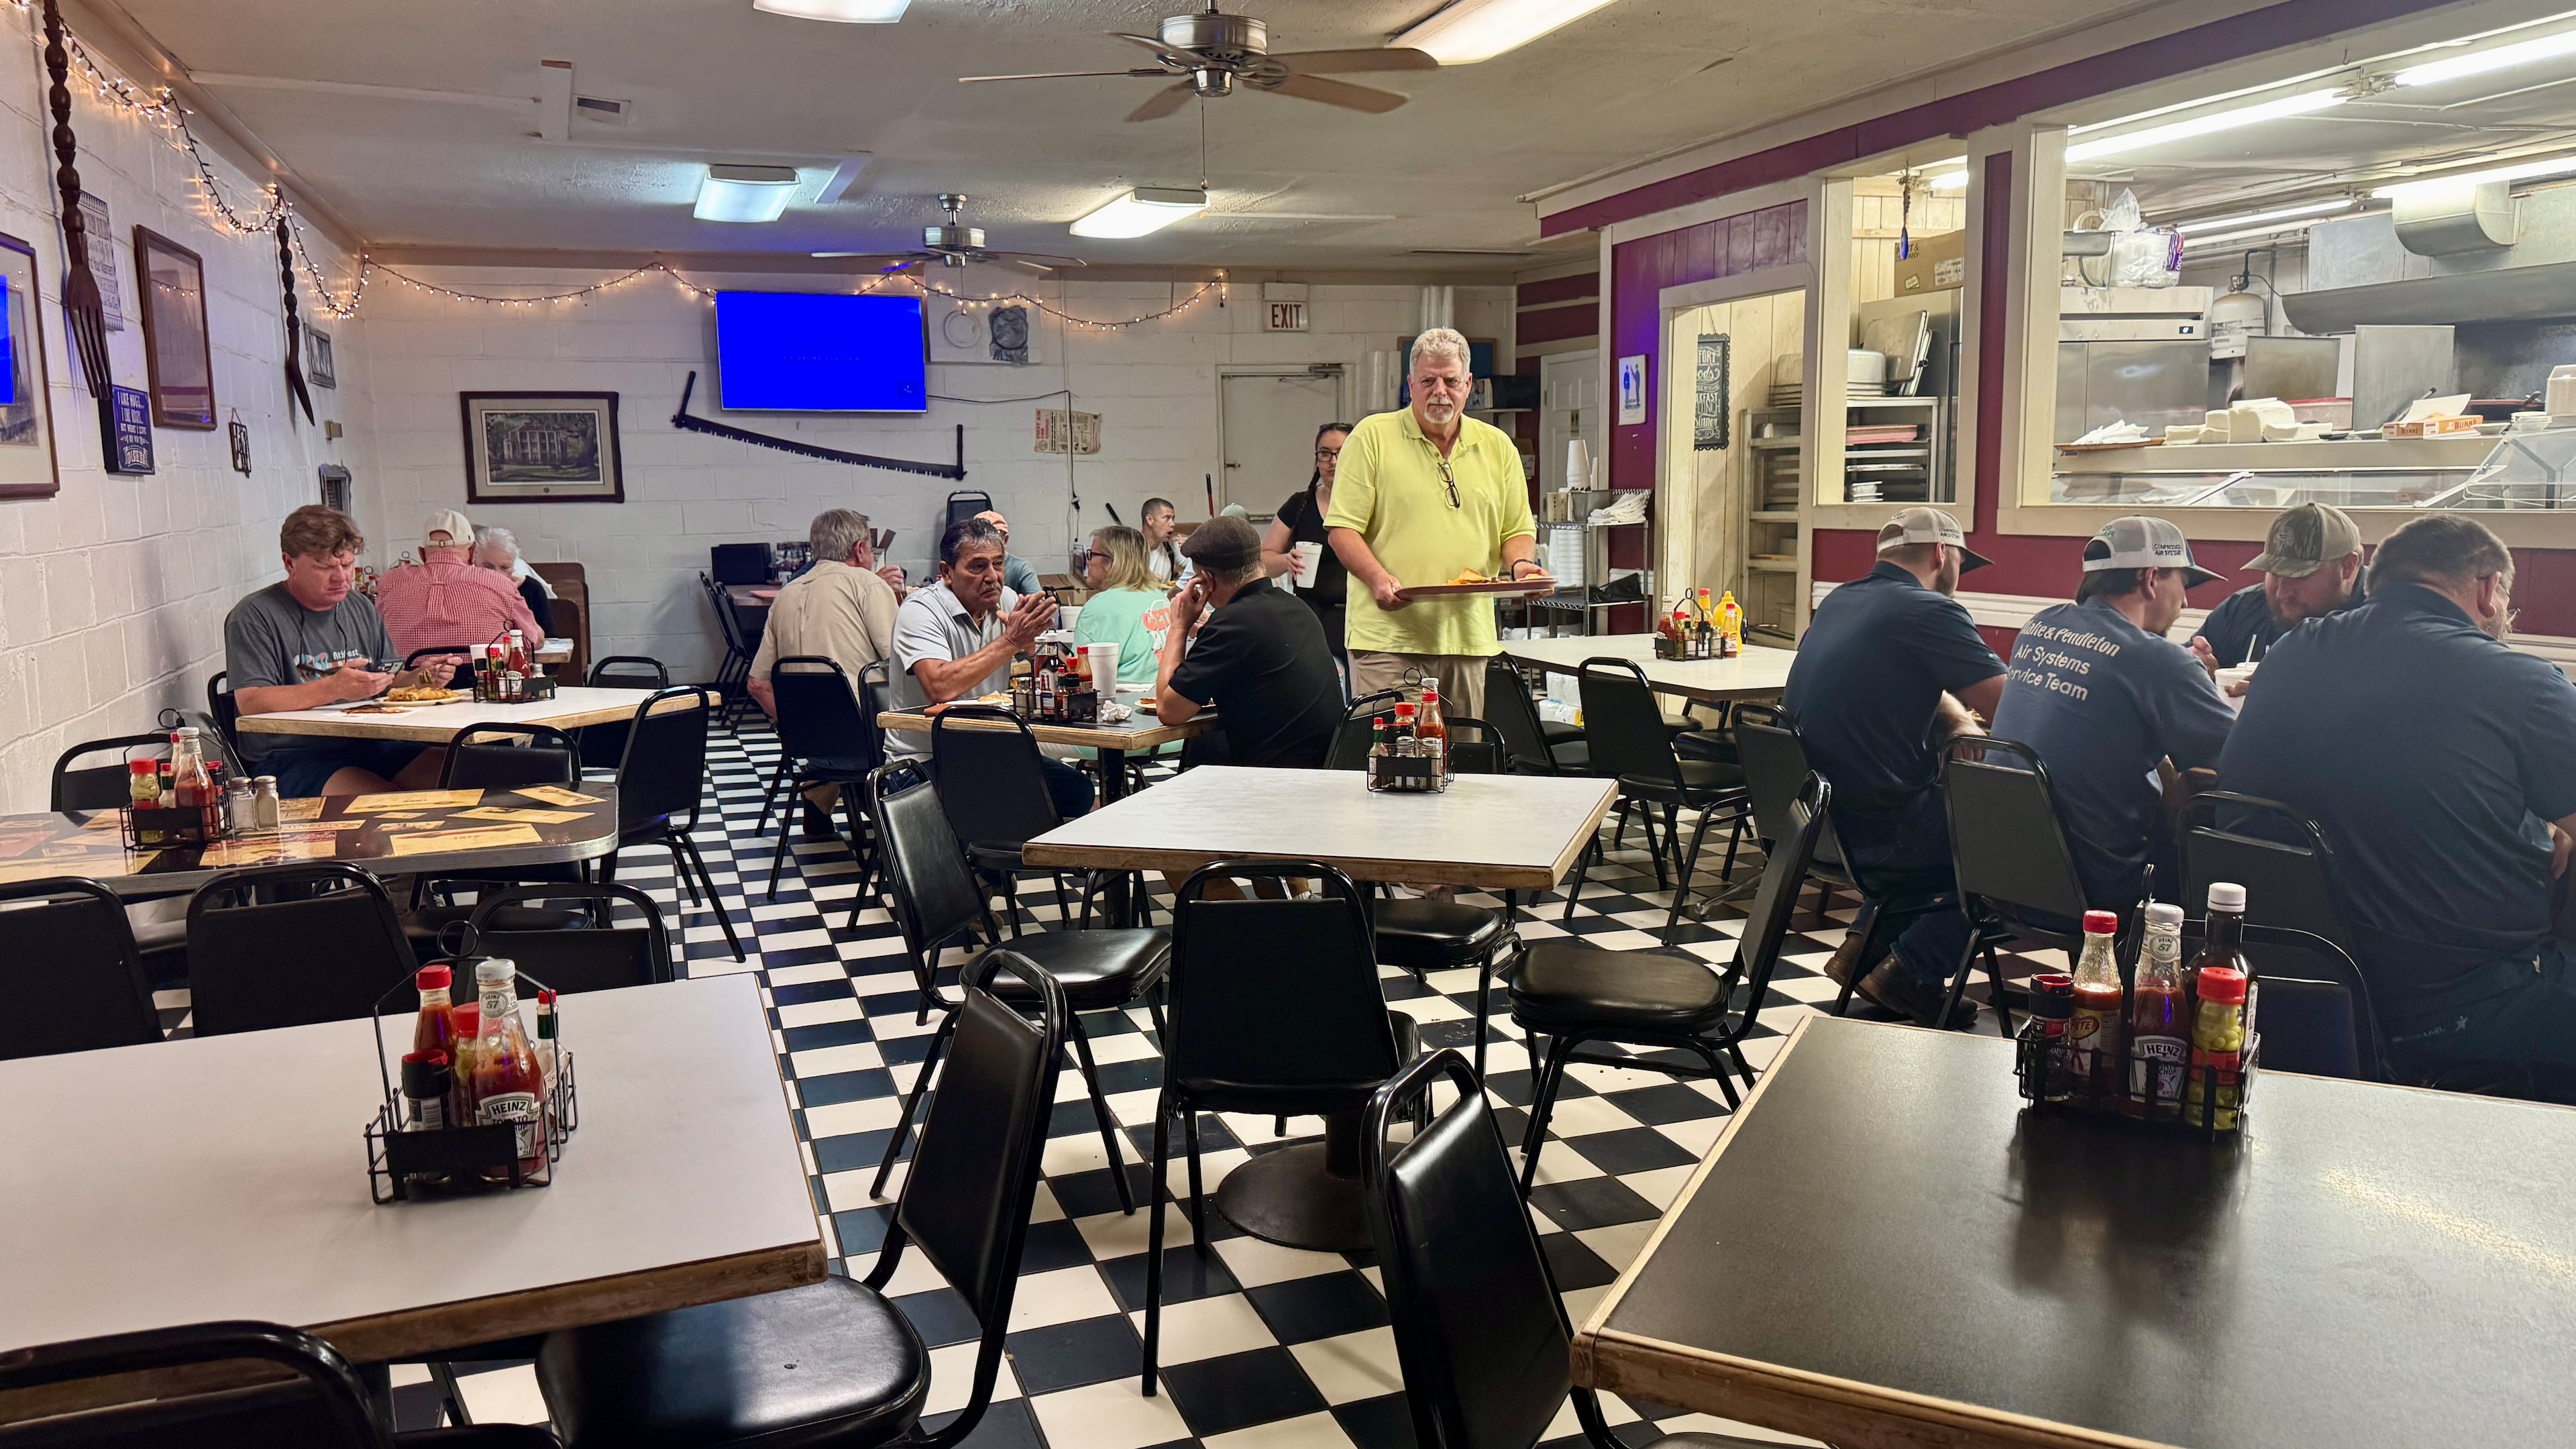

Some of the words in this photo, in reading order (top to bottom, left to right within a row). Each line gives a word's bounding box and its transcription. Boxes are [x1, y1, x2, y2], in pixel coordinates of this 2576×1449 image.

[1271, 304, 1301, 328] EXIT
[1698, 350, 1716, 364] FORT
[1697, 367, 1720, 380] ods
[1697, 392, 1718, 404] AKFAST
[2043, 627, 2056, 639] &
[2053, 628, 2121, 657] Pendleton
[333, 648, 359, 661] Athest
[2014, 644, 2032, 659] Air
[2033, 646, 2091, 675] Systems
[2045, 672, 2088, 701] Team
[2158, 943, 2172, 952] 57
[486, 1000, 499, 1009] 57
[2147, 1044, 2180, 1057] HEINZ
[492, 1102, 527, 1115] HEINZ
[492, 1115, 528, 1125] TOATO
